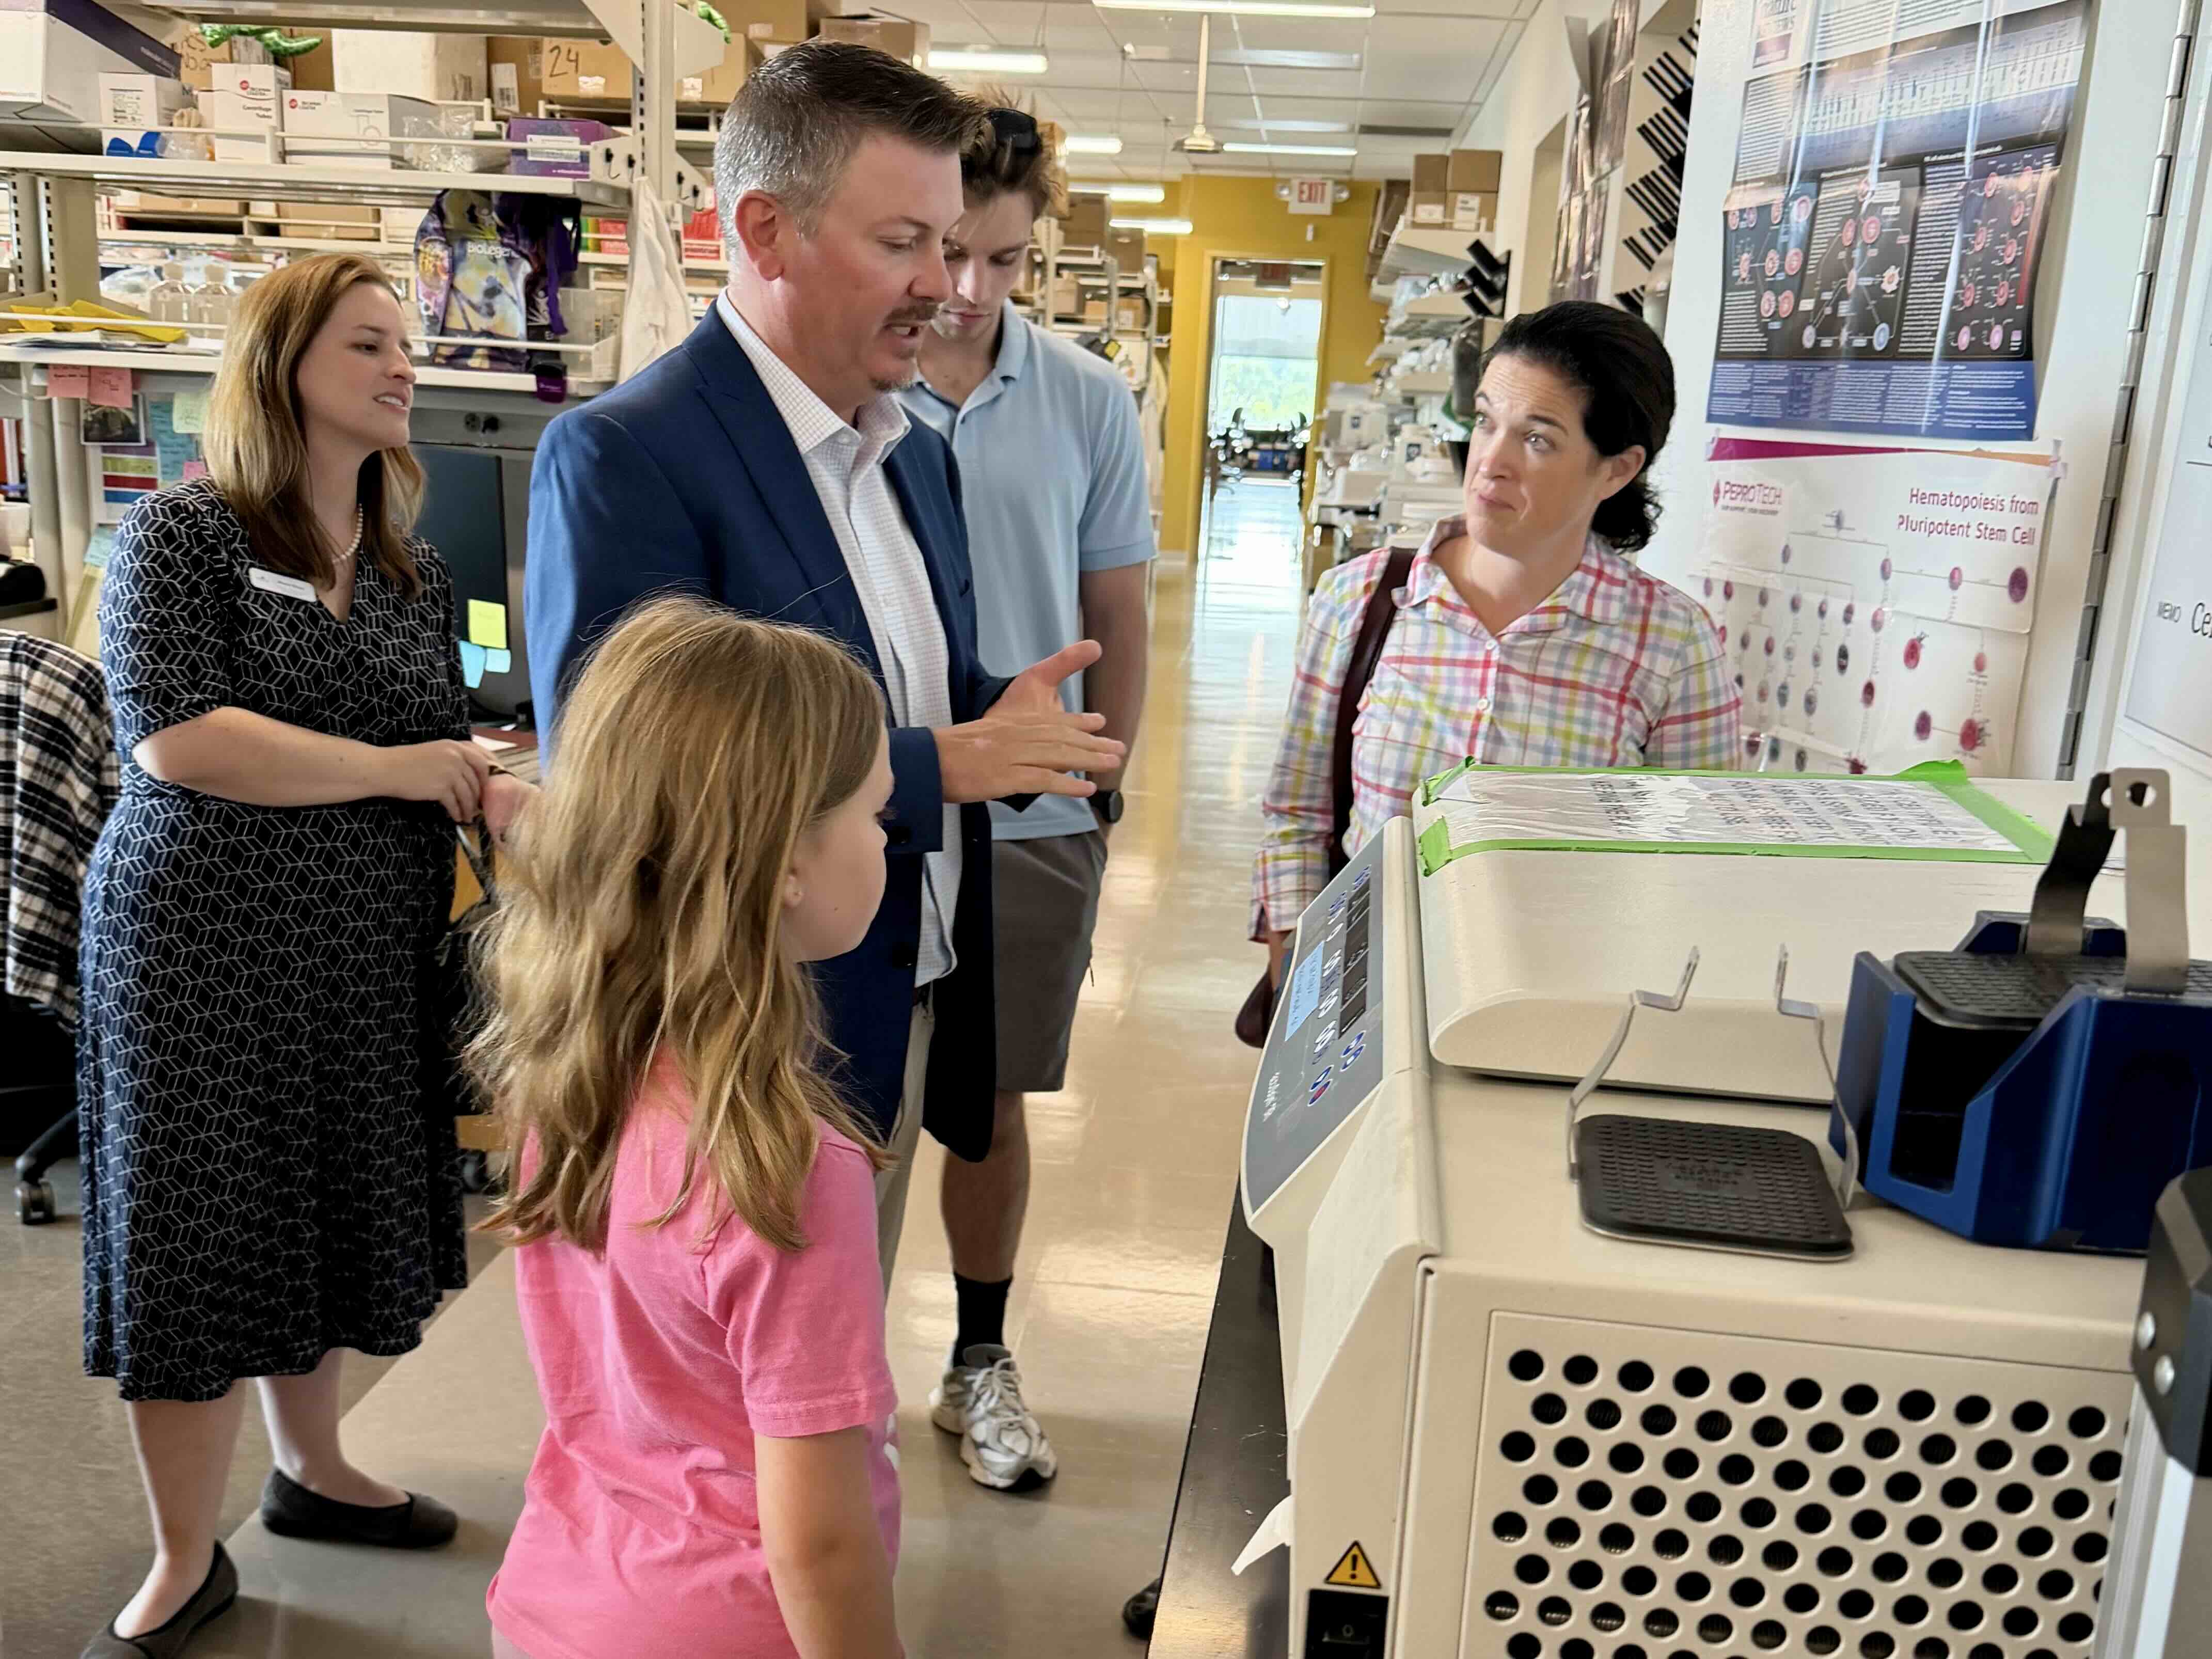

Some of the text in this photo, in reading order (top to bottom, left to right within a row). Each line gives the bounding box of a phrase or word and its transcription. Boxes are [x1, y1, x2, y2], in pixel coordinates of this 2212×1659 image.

[548, 44, 579, 77] 24
[1298, 181, 1326, 203] EXIT
[1910, 488, 2039, 514] Hematopoiesis from
[1898, 515, 2035, 545] Pluripotent Stem Cell
